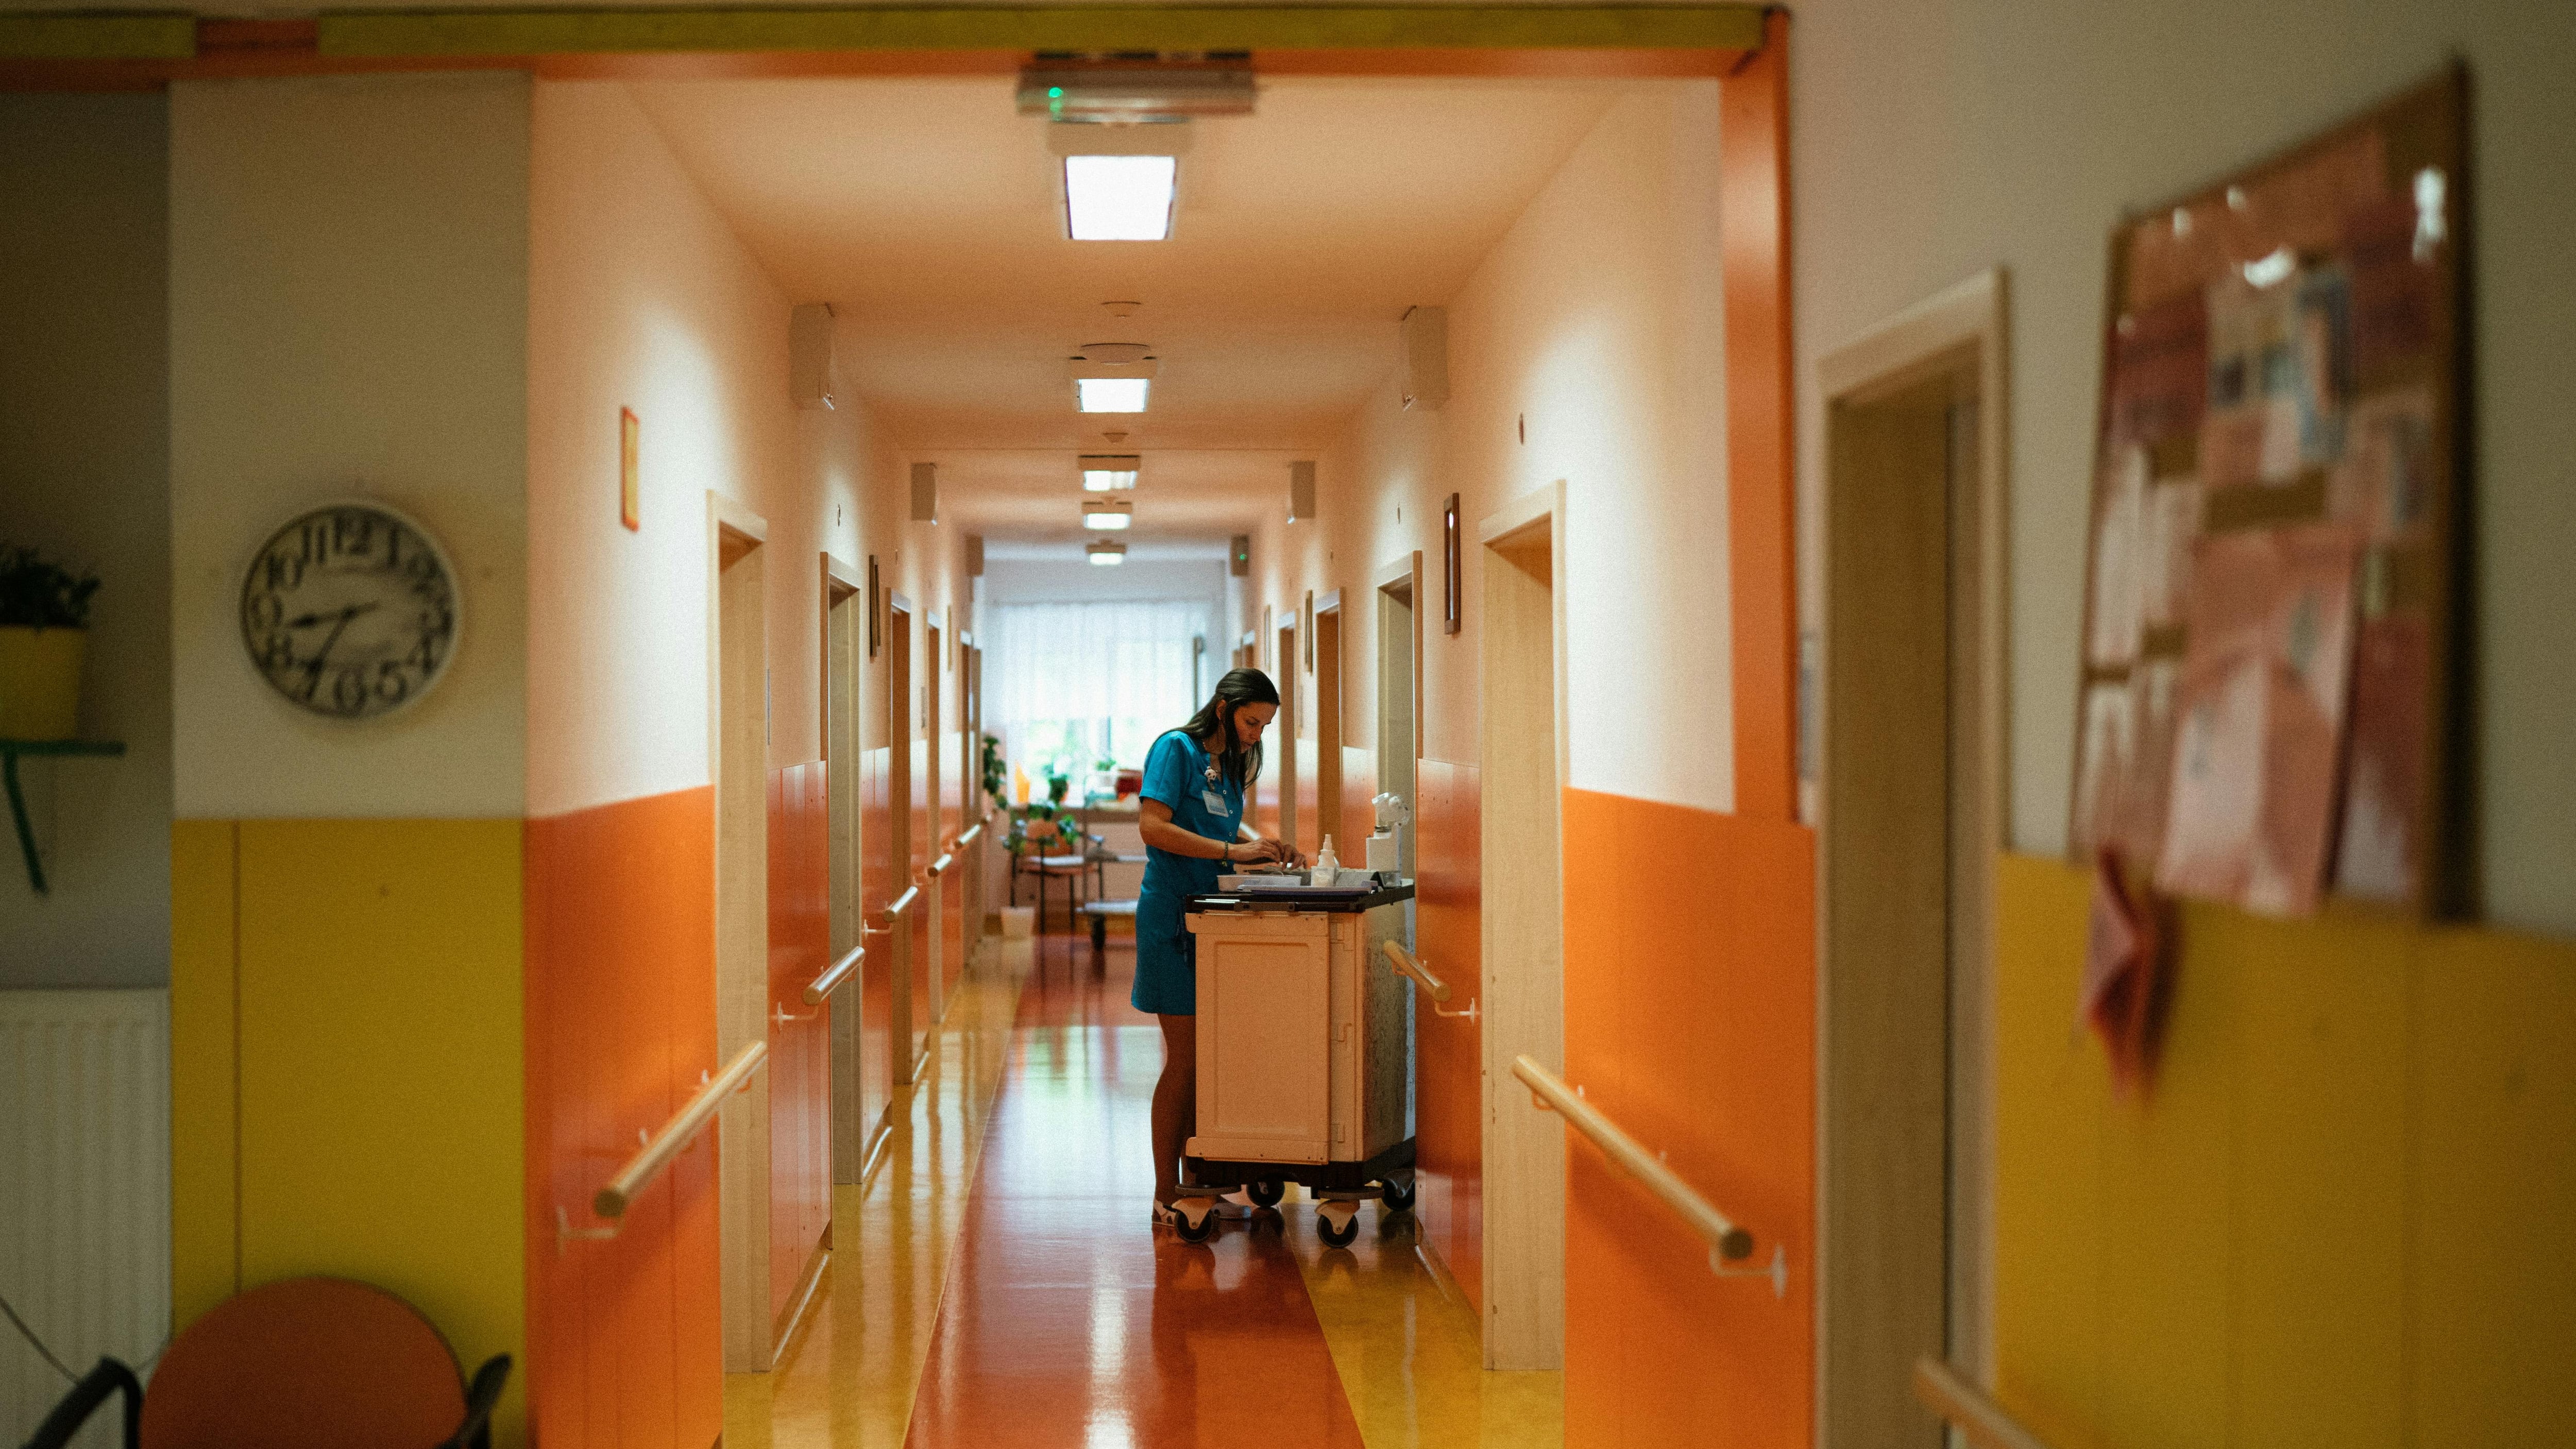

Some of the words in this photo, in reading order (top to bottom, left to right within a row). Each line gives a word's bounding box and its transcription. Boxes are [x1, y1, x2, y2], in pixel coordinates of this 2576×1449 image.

[302, 523, 327, 565] 11
[333, 514, 371, 555] 12
[267, 553, 304, 591] 10
